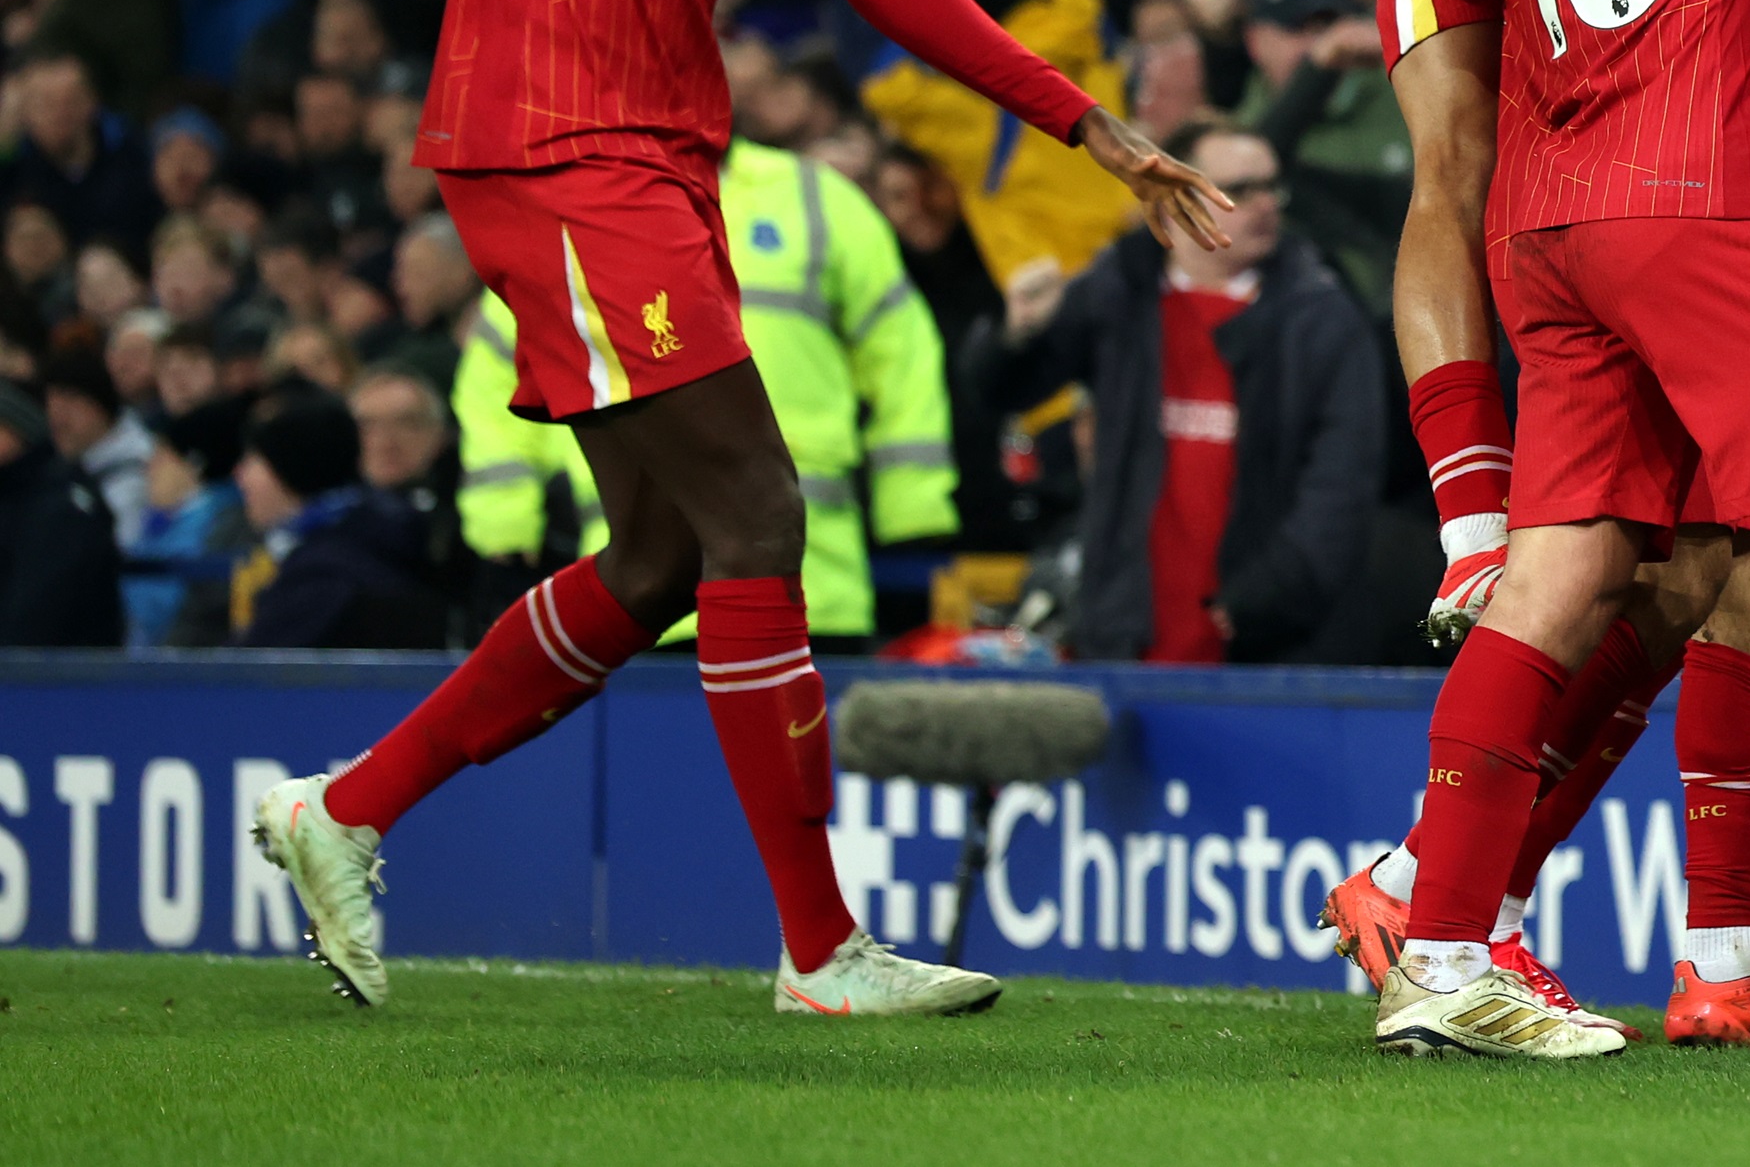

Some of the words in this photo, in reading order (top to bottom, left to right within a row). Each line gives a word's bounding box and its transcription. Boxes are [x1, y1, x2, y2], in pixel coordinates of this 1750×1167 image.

[650, 338, 685, 359] LFC
[1428, 768, 1463, 787] LFC
[1689, 804, 1727, 821] LFC
[0, 755, 384, 951] STOR
[986, 778, 1584, 994] Christor
[1366, 900, 1408, 933] F5
